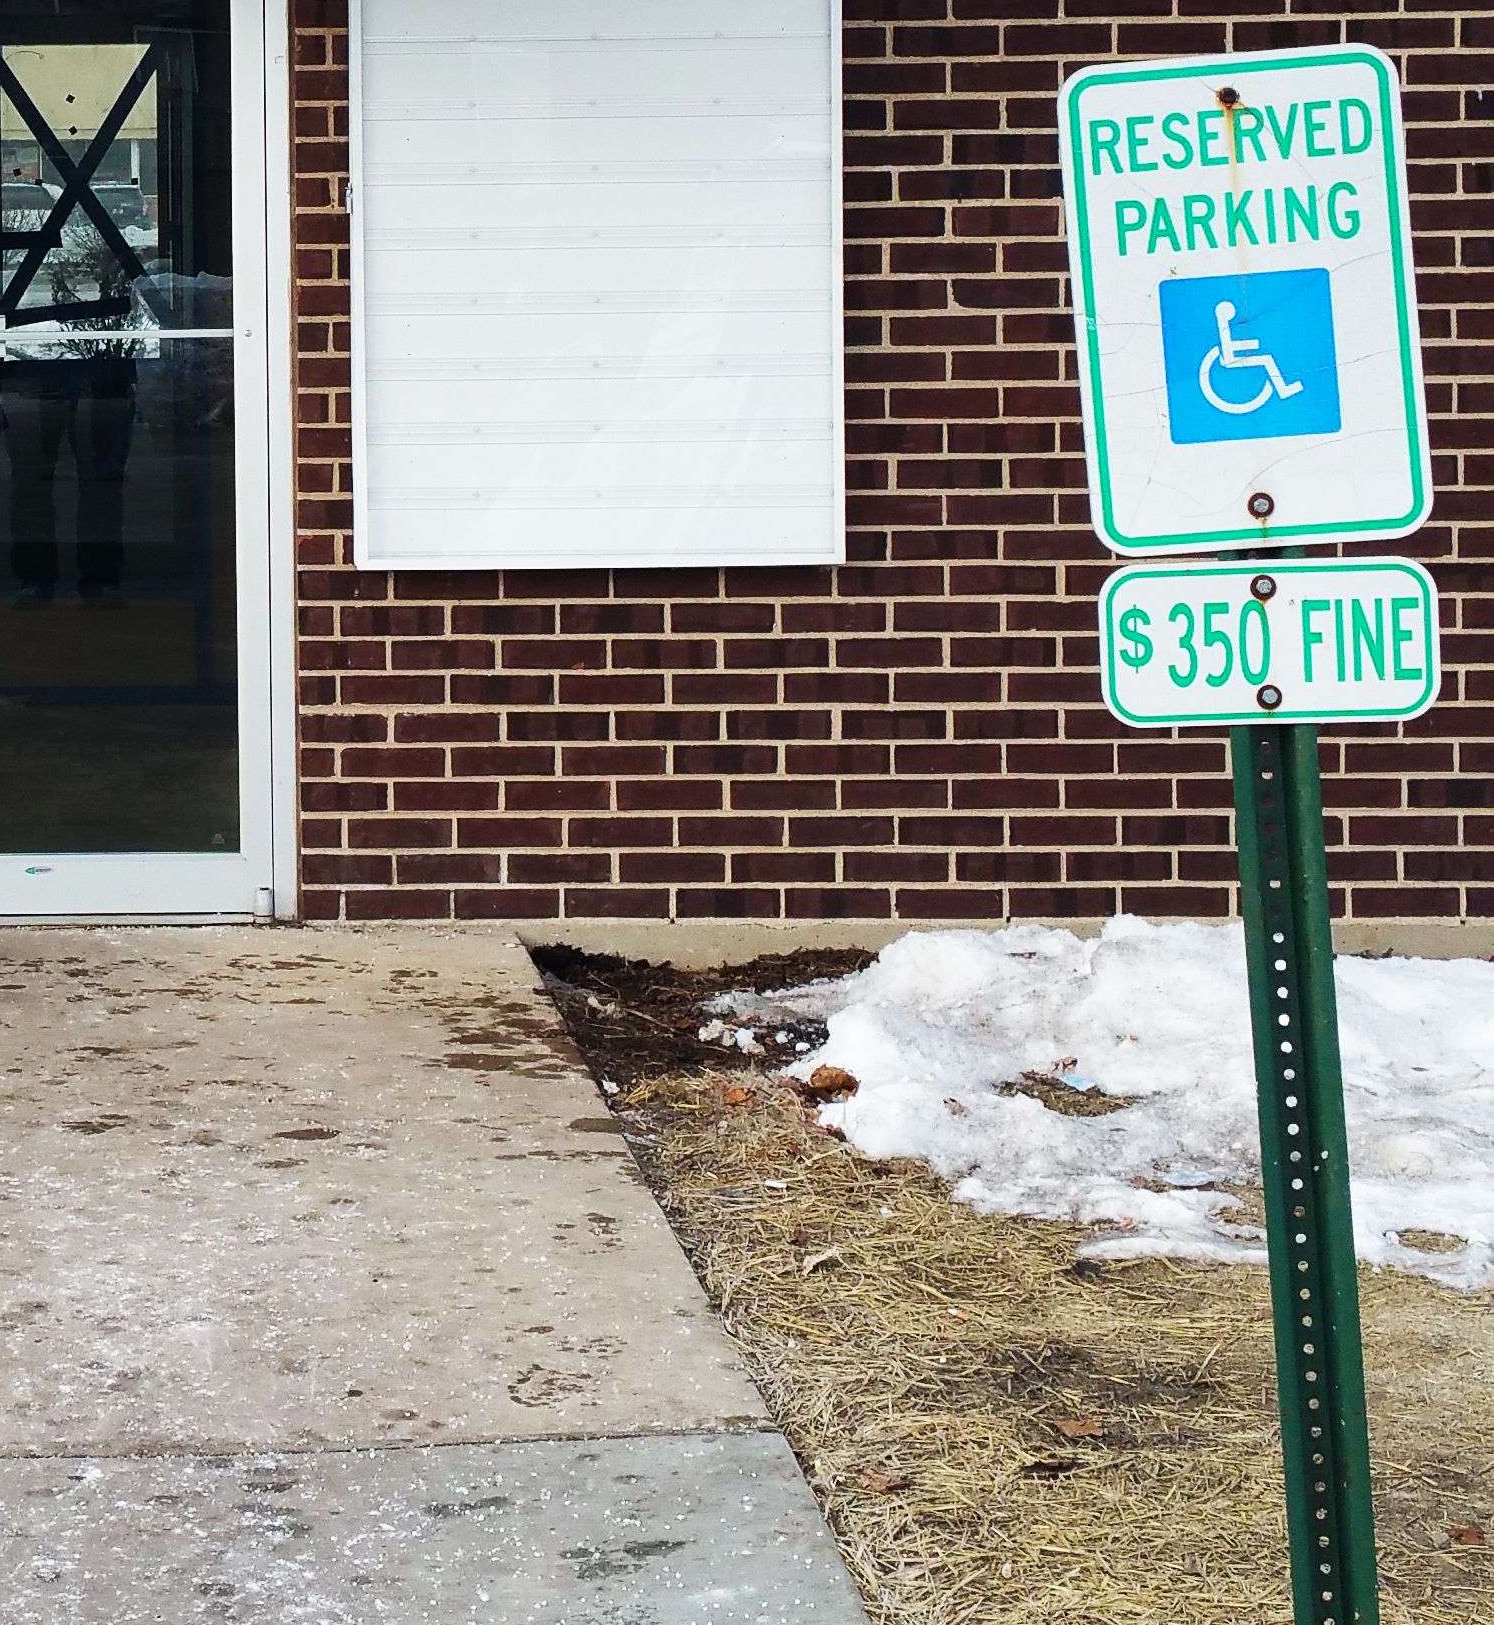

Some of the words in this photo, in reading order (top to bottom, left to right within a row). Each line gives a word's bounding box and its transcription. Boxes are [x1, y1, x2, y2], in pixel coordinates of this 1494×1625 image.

[1088, 97, 1373, 177] RESERVED
[1114, 180, 1361, 257] PARKING
[1300, 596, 1424, 683] FINE
